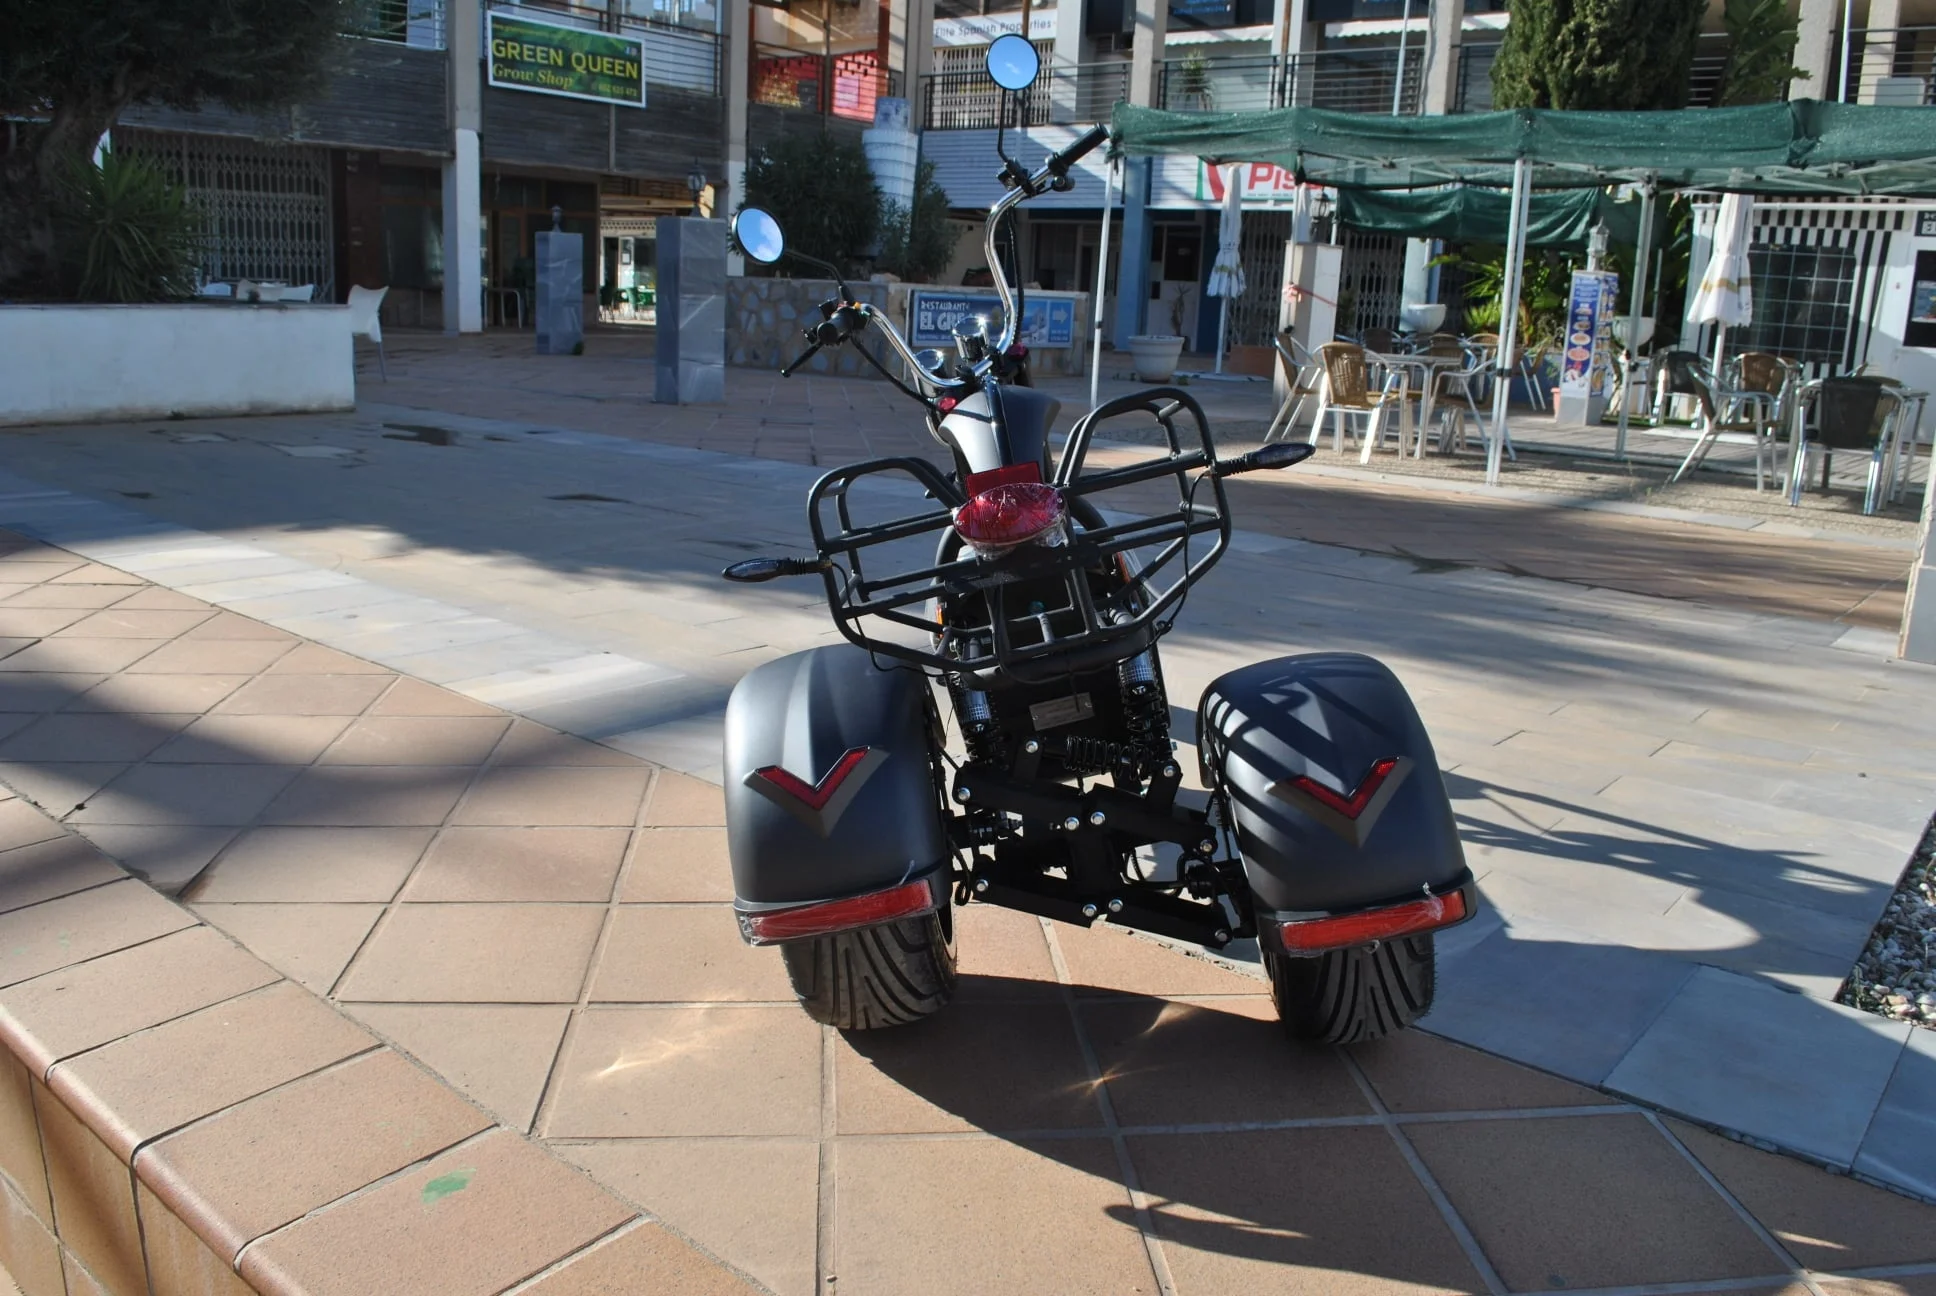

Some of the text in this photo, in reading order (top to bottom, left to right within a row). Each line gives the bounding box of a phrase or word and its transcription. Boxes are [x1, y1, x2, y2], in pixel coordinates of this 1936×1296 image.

[959, 23, 997, 37] Spanish
[1000, 19, 1051, 33] Proprties
[493, 39, 638, 80] GREEN QUEEN
[493, 63, 534, 81] Grow
[537, 70, 574, 90] Shop
[921, 300, 970, 311] RESTAURANTE
[919, 311, 935, 330] EL
